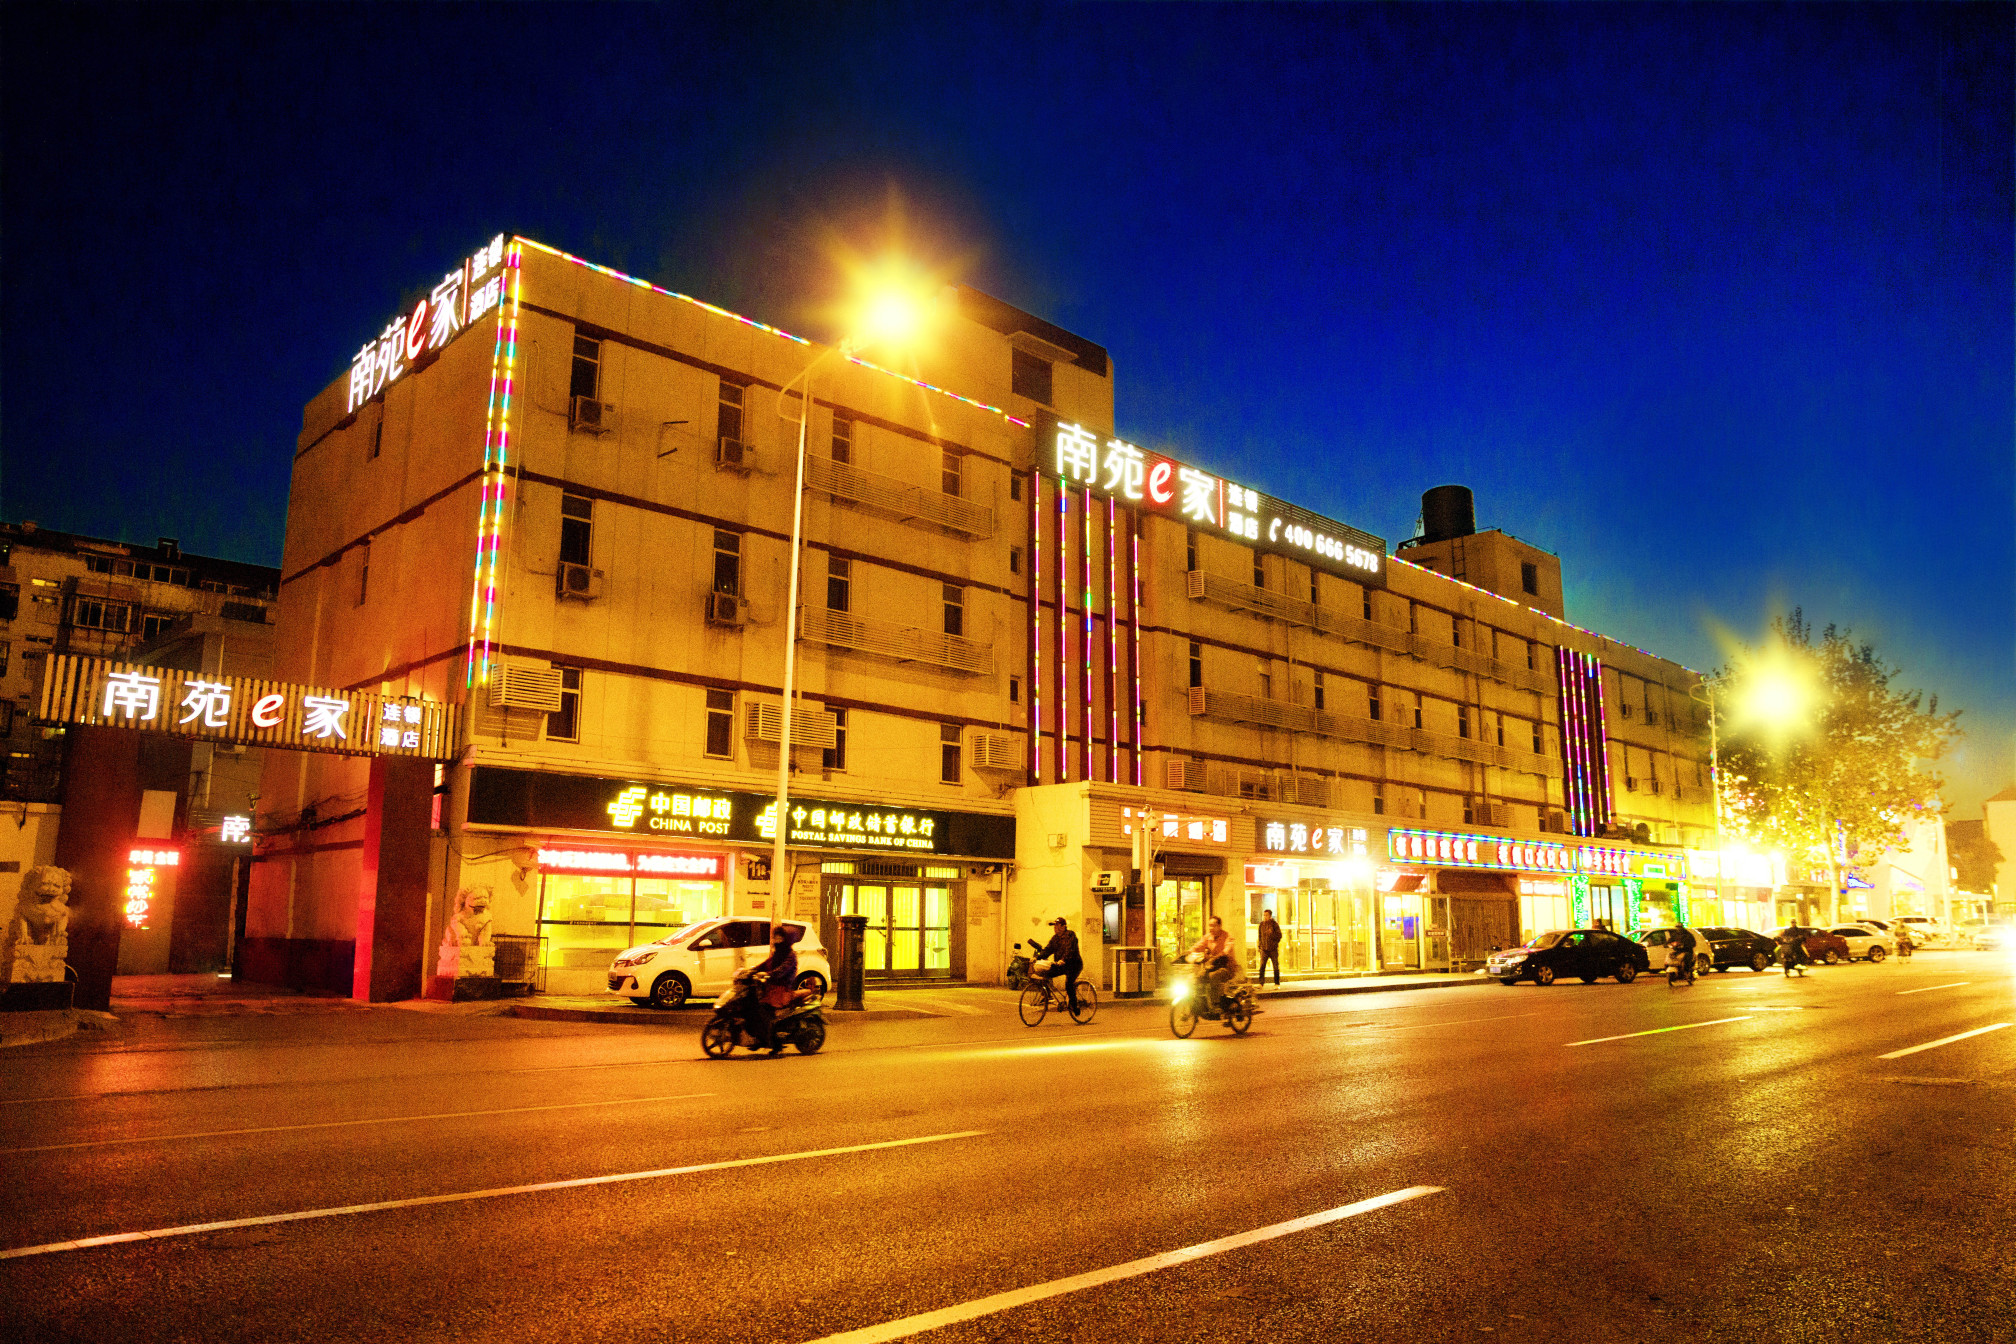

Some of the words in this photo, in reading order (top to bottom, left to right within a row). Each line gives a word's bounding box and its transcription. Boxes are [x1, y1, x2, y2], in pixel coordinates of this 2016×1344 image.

[348, 269, 463, 413] 南苑e家
[1056, 421, 1216, 525] 南苑e家
[1284, 524, 1313, 550] 400
[1315, 534, 1344, 561] 666
[1345, 545, 1378, 573] 5678
[103, 671, 349, 740] 南苑e家
[650, 791, 732, 820] 中国邮政
[791, 805, 935, 837] 中国邮政储蓄银行
[649, 817, 692, 832] CHINA
[698, 821, 730, 834] POST
[791, 830, 826, 841] POSTAL
[828, 832, 867, 844] SAVINGS
[868, 836, 893, 846] BANK
[893, 838, 906, 847] OF
[906, 839, 934, 849] CHINA
[1266, 821, 1344, 855] 南苑e家
